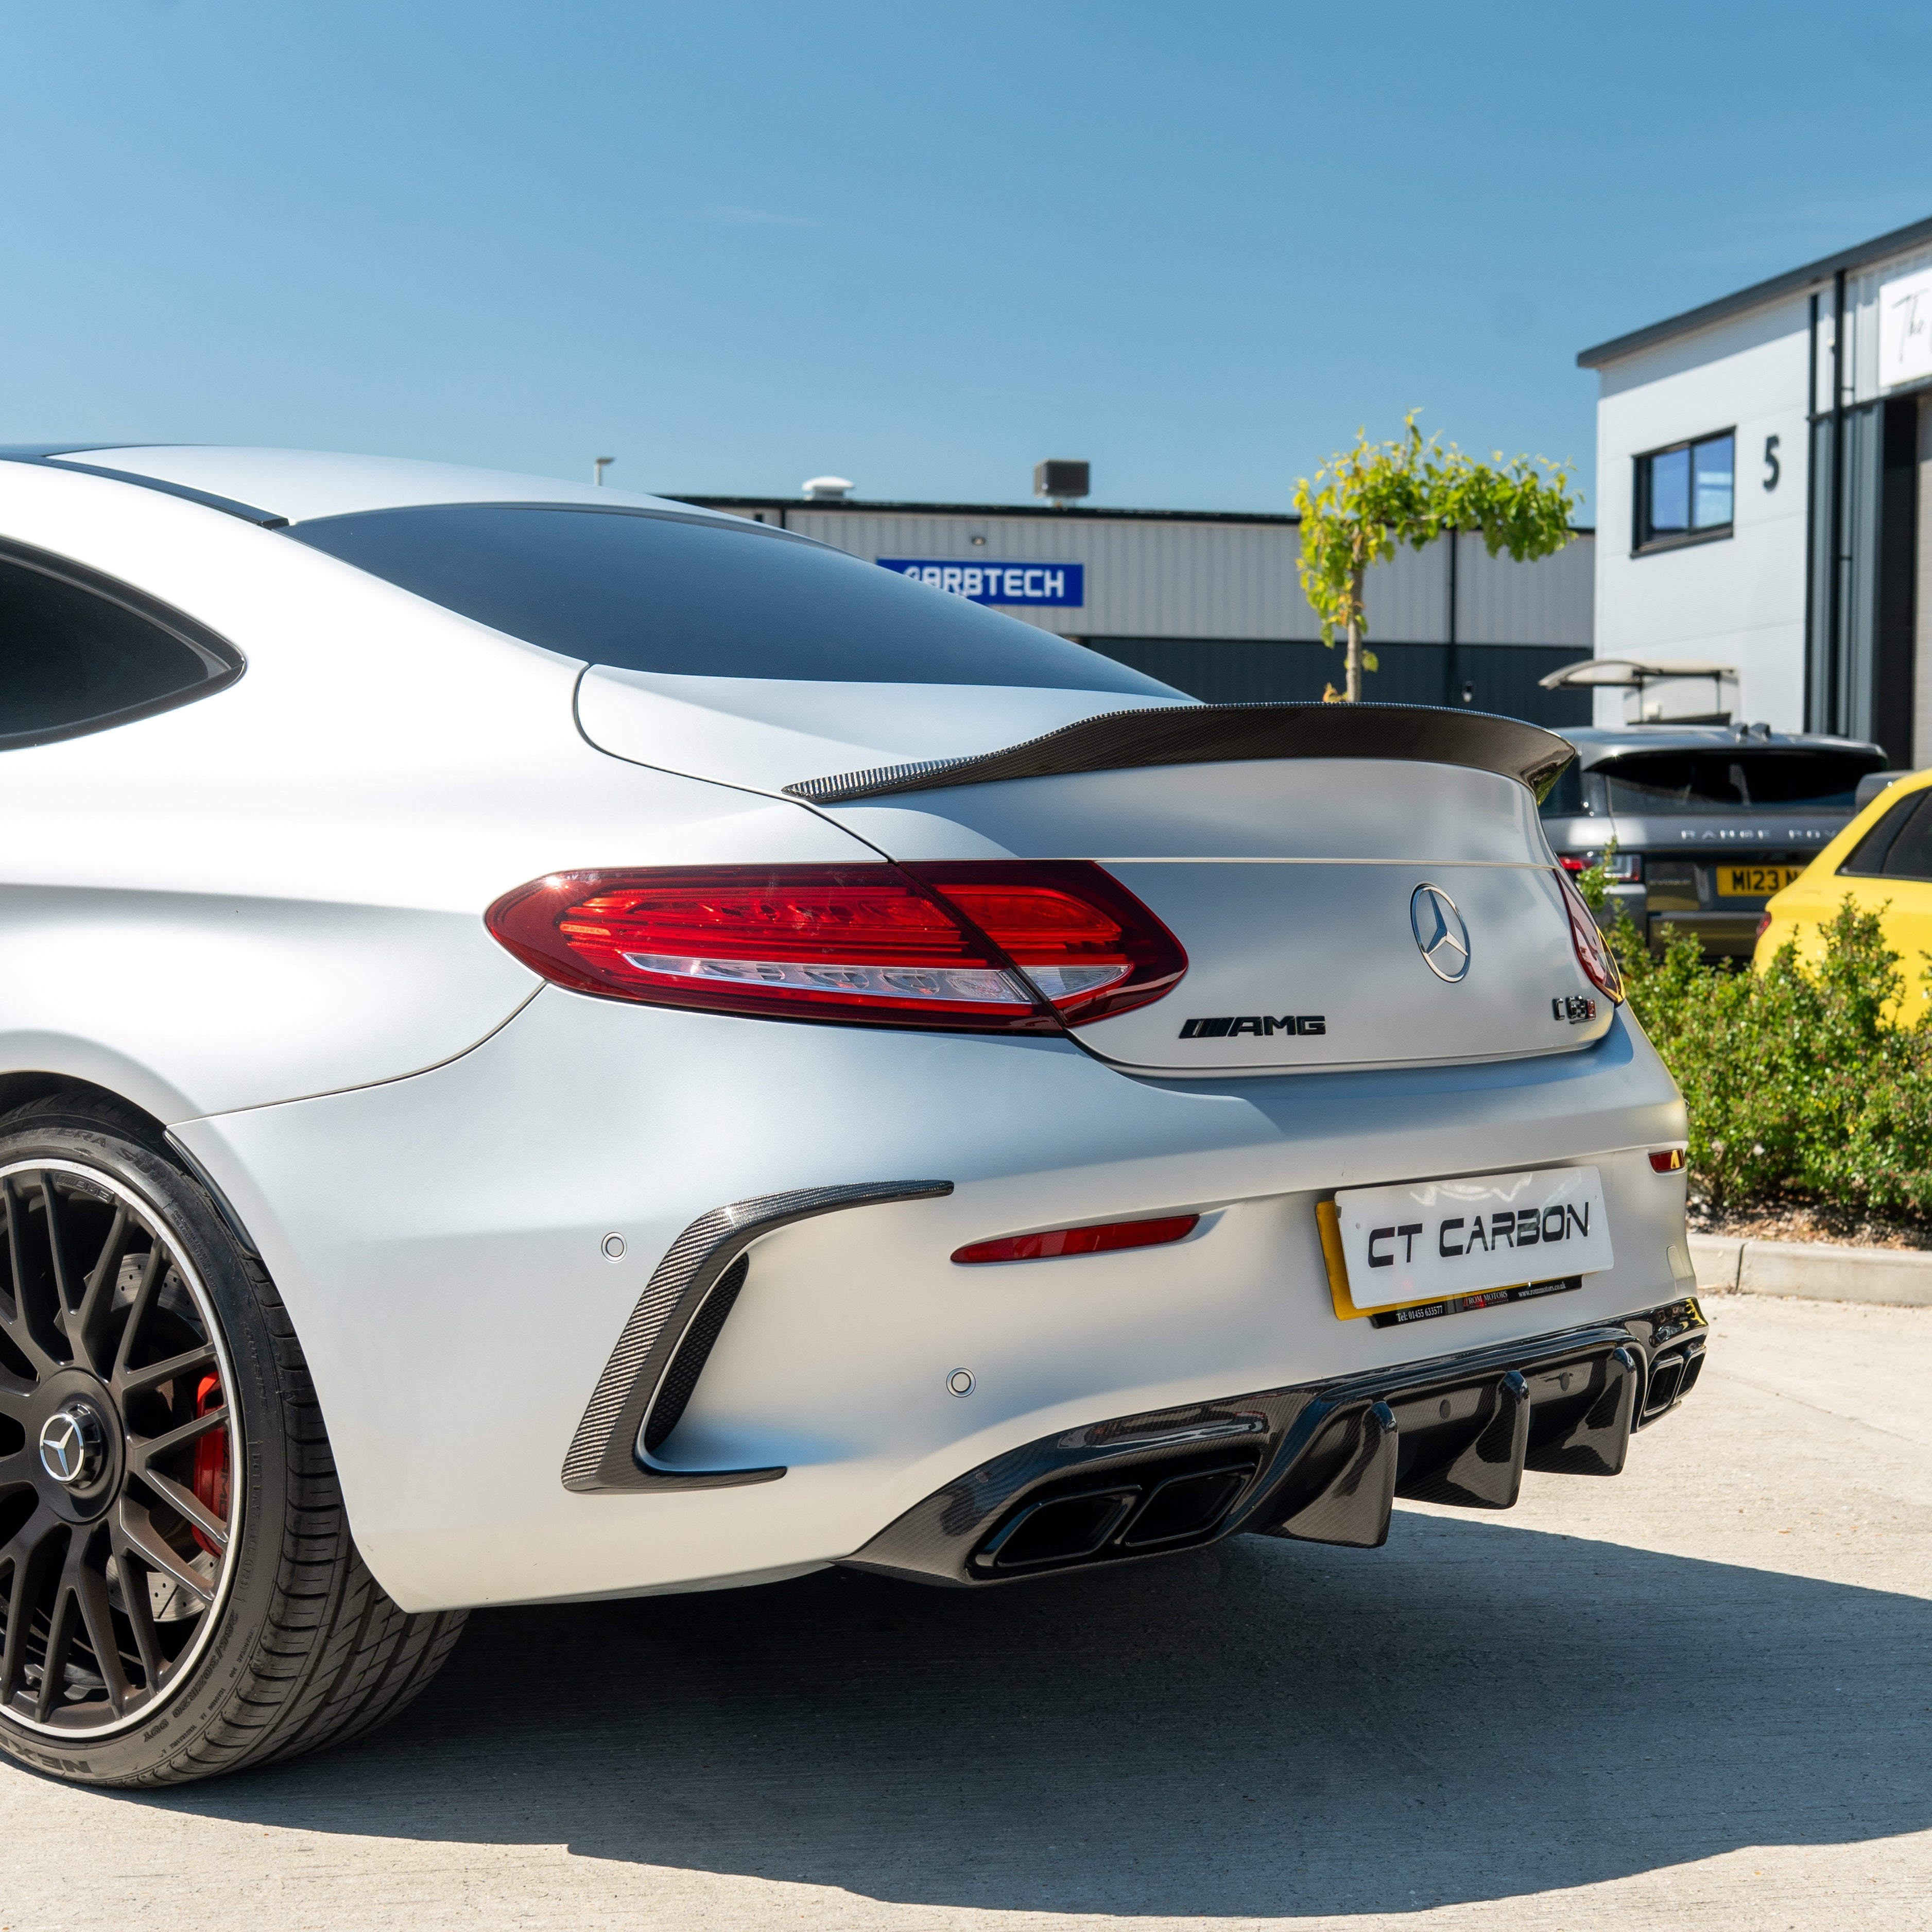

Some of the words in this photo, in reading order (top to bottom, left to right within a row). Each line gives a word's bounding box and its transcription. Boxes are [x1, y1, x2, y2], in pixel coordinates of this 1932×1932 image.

[1763, 434, 1780, 492] 5
[1681, 830, 1770, 839] RANGE
[1732, 870, 1779, 891] M123
[1227, 1015, 1326, 1037] AMG
[1368, 1223, 1423, 1268] CT
[1439, 1202, 1589, 1257] CARBON
[1469, 1295, 1482, 1304] ROM
[1484, 1290, 1508, 1301] MOTORS
[1396, 1312, 1408, 1322] Tel:
[1408, 1308, 1424, 1319] 01455
[1425, 1305, 1442, 1317] 633577
